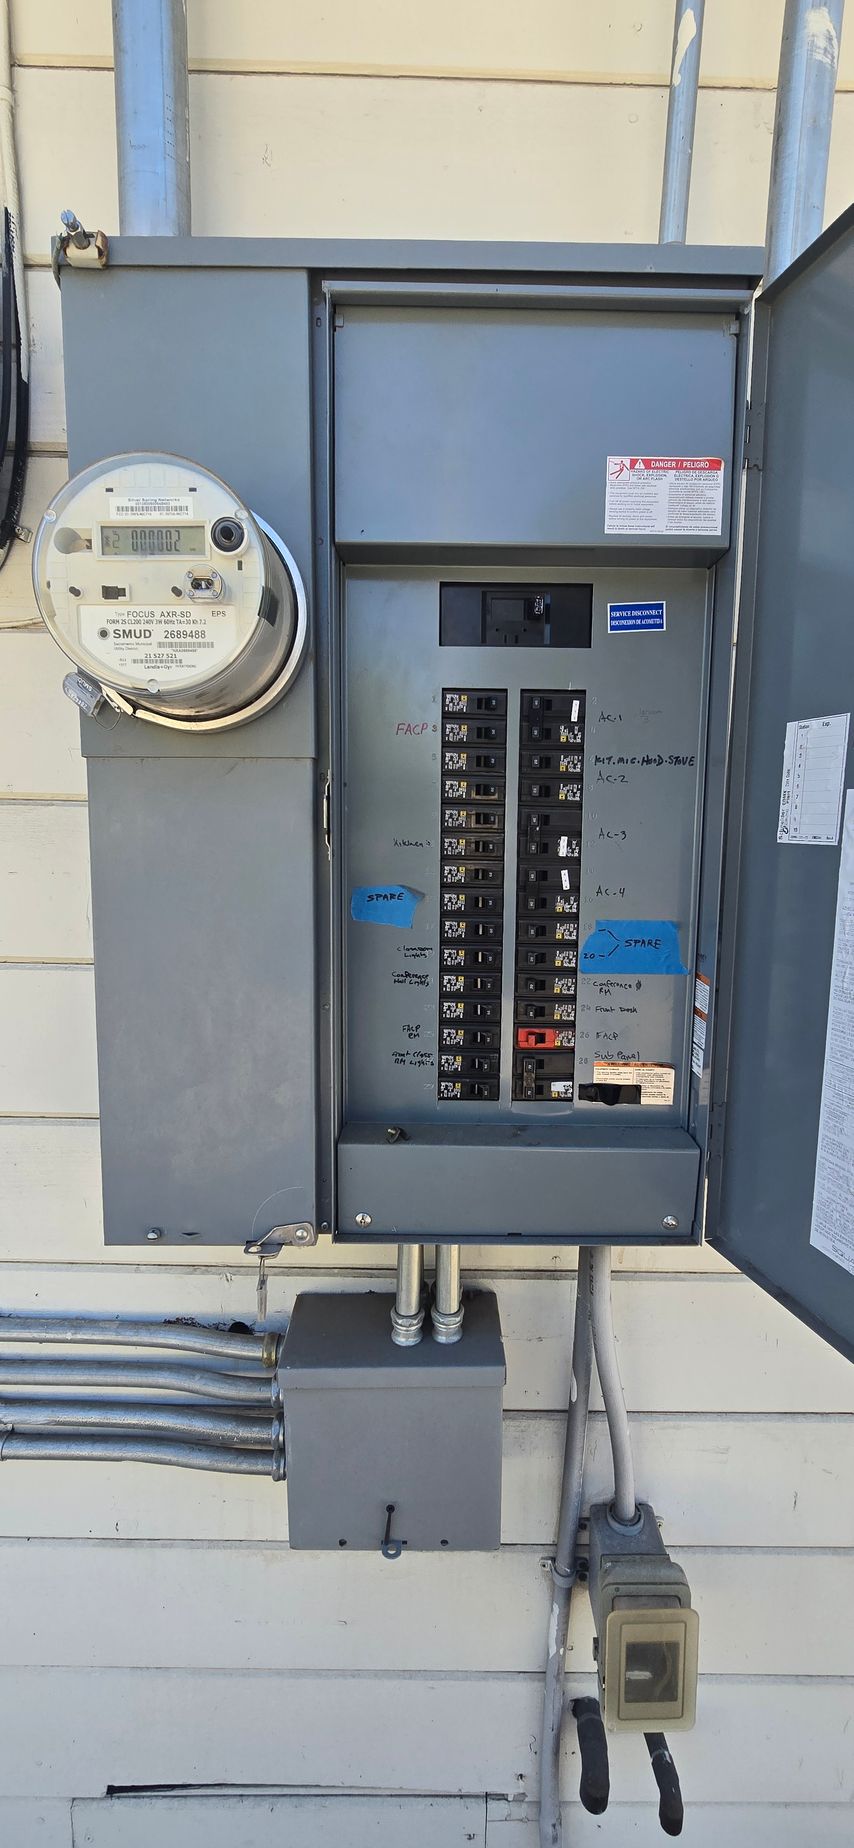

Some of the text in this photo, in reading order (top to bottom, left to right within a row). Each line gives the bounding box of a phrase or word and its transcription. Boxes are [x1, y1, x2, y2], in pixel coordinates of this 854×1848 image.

[131, 529, 181, 552] 000002
[126, 610, 155, 618] FOCUS
[160, 610, 192, 618] AXR-SD
[113, 629, 206, 639] SMUD 2689488
[596, 770, 629, 784] AC-2
[598, 827, 627, 840] AC-3
[366, 892, 405, 902] SPARE
[596, 885, 626, 898] AC-4
[624, 938, 662, 950] SPARE
[592, 979, 632, 990] Conference
[594, 1050, 640, 1061] Sub Panel
